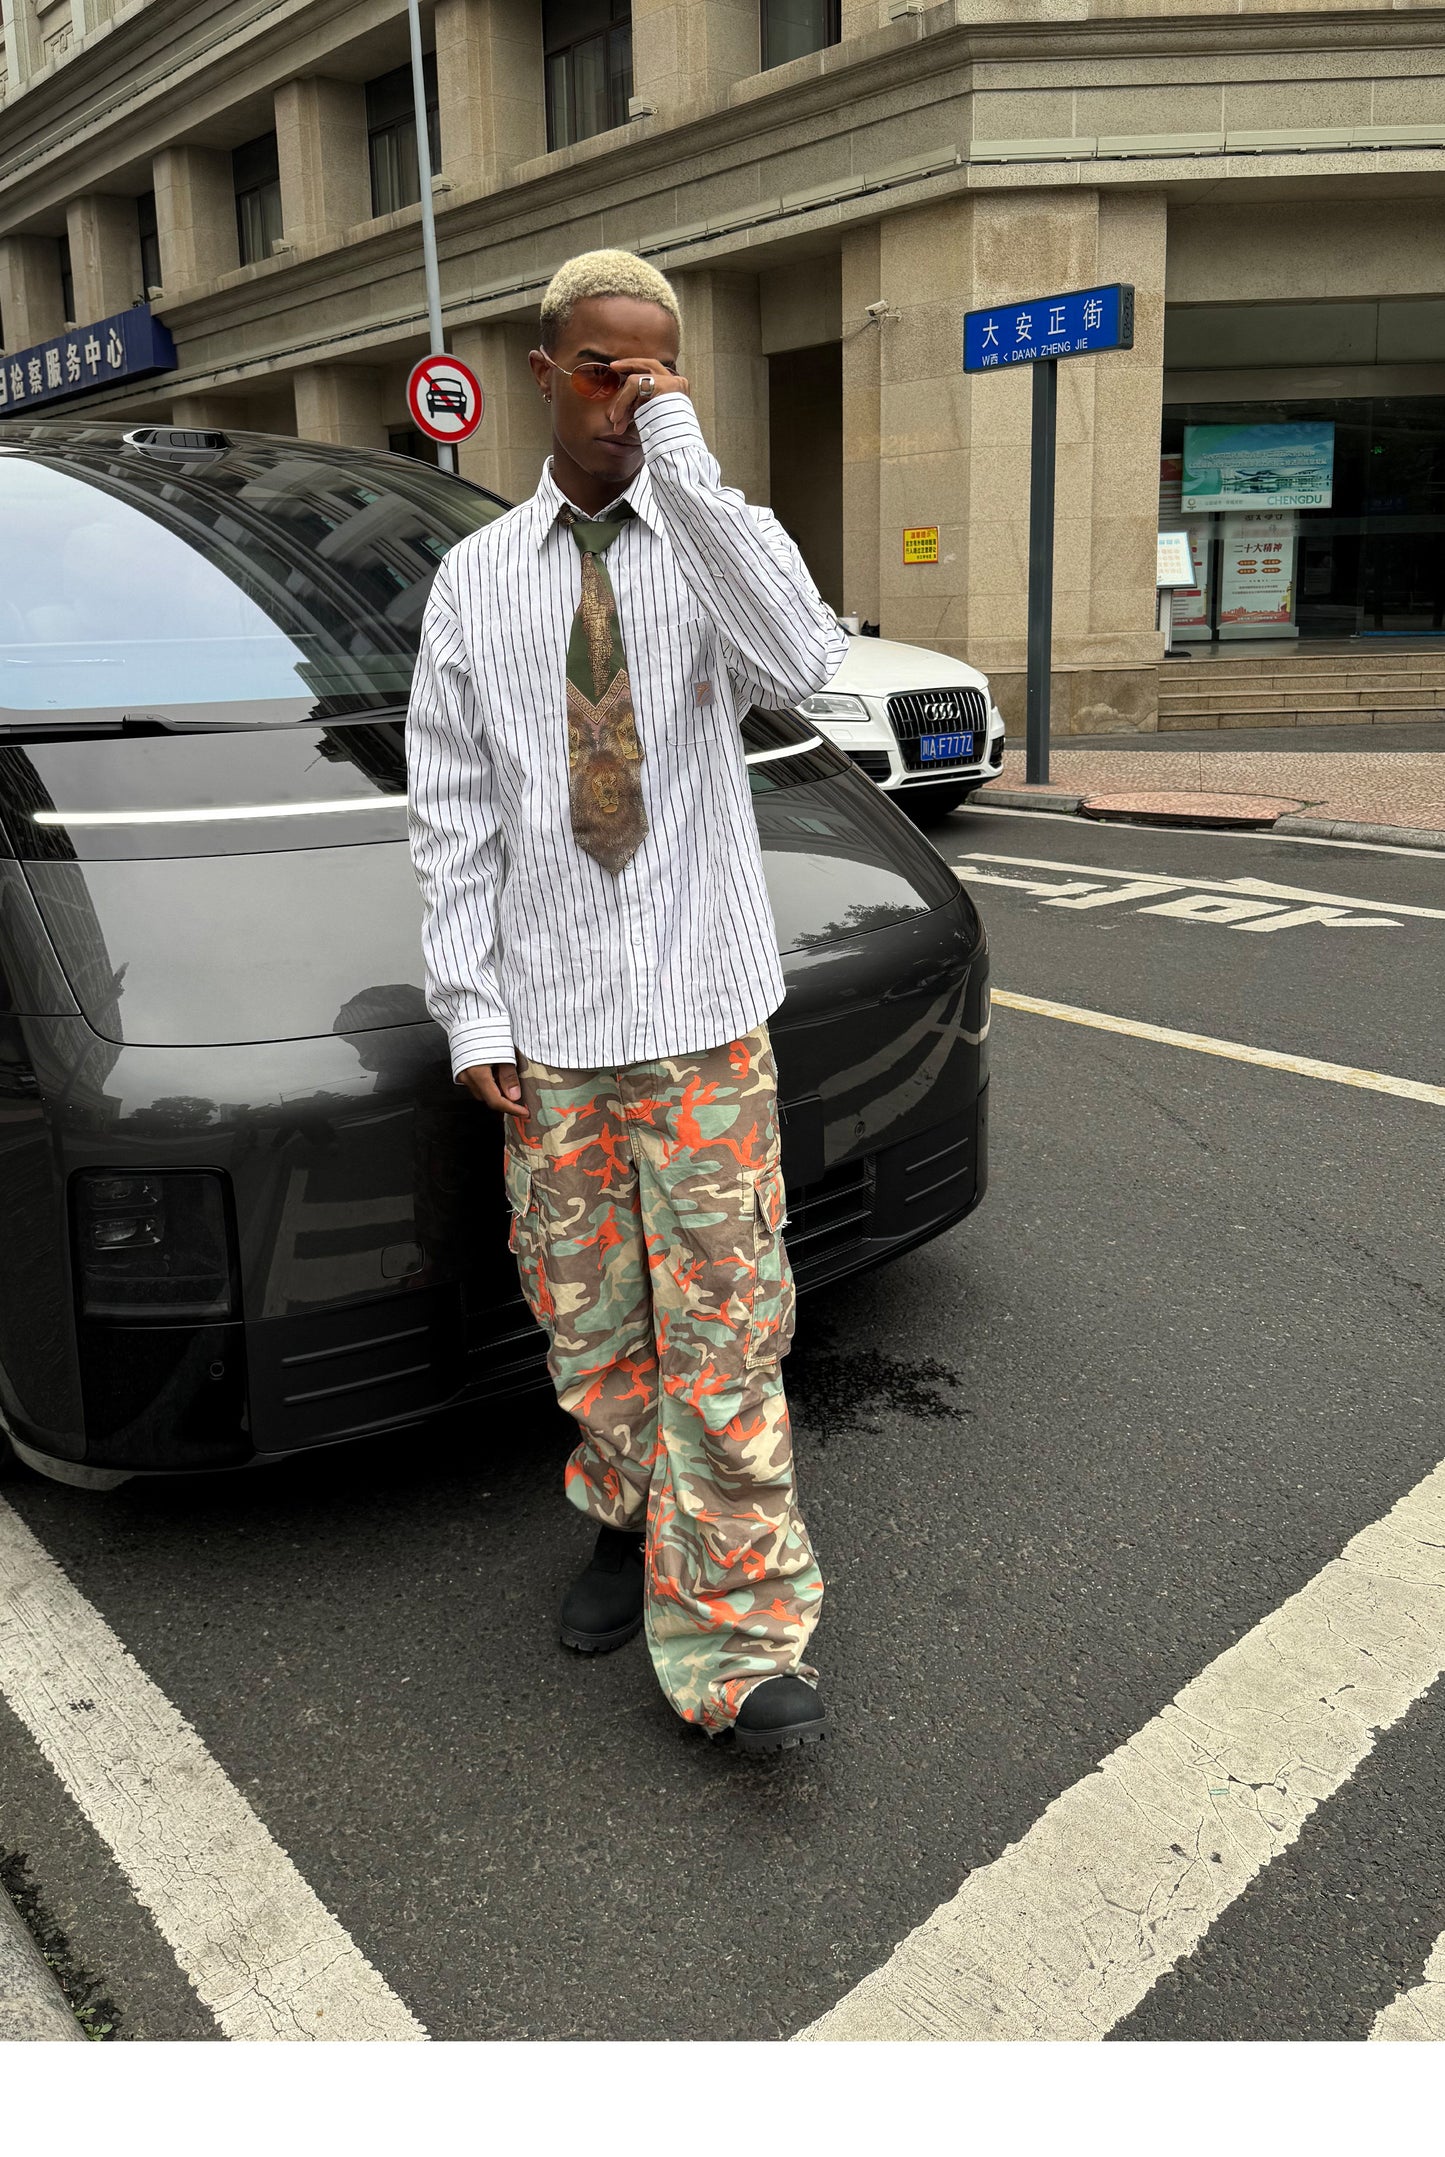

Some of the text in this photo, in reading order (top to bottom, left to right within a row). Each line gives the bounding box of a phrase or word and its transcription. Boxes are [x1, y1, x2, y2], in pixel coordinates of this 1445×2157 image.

[981, 299, 1103, 348] 大安正街
[1011, 347, 1037, 362] DA'AN
[1040, 341, 1071, 356] ZHENG
[1075, 338, 1088, 350] JIE
[1266, 494, 1323, 506] CHENGDU
